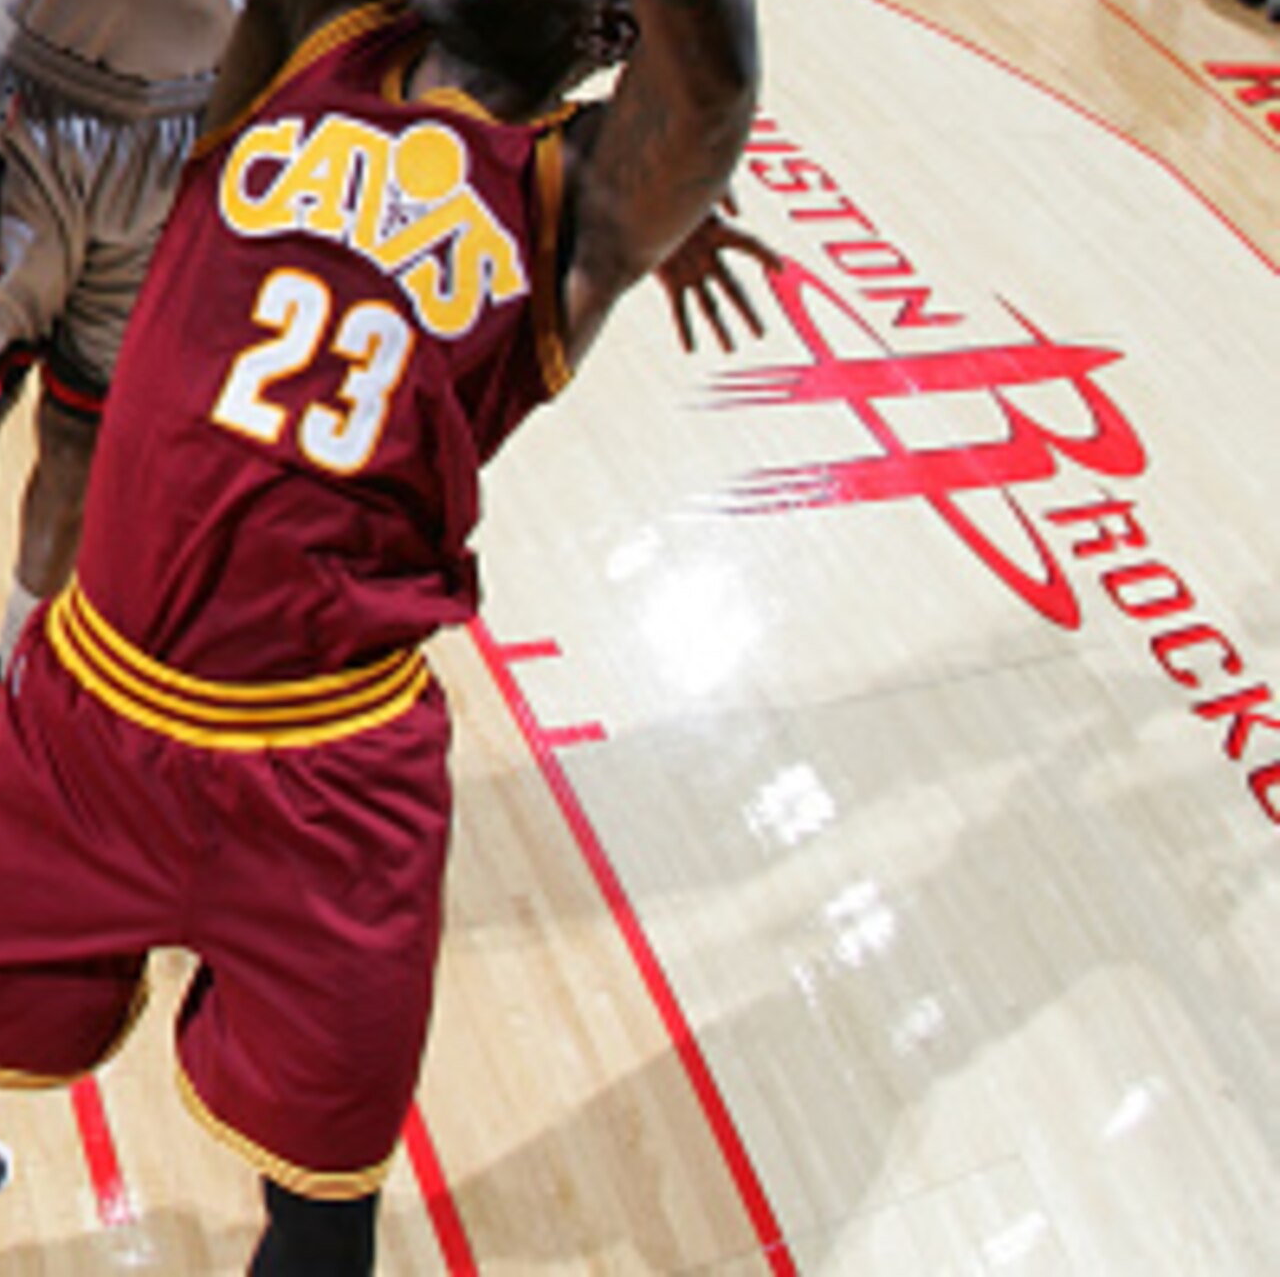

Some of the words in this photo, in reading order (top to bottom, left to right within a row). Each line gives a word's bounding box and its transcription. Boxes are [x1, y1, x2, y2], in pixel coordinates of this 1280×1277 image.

[218, 111, 531, 341] CAVS
[740, 107, 968, 329] USTON
[210, 265, 418, 476] 23
